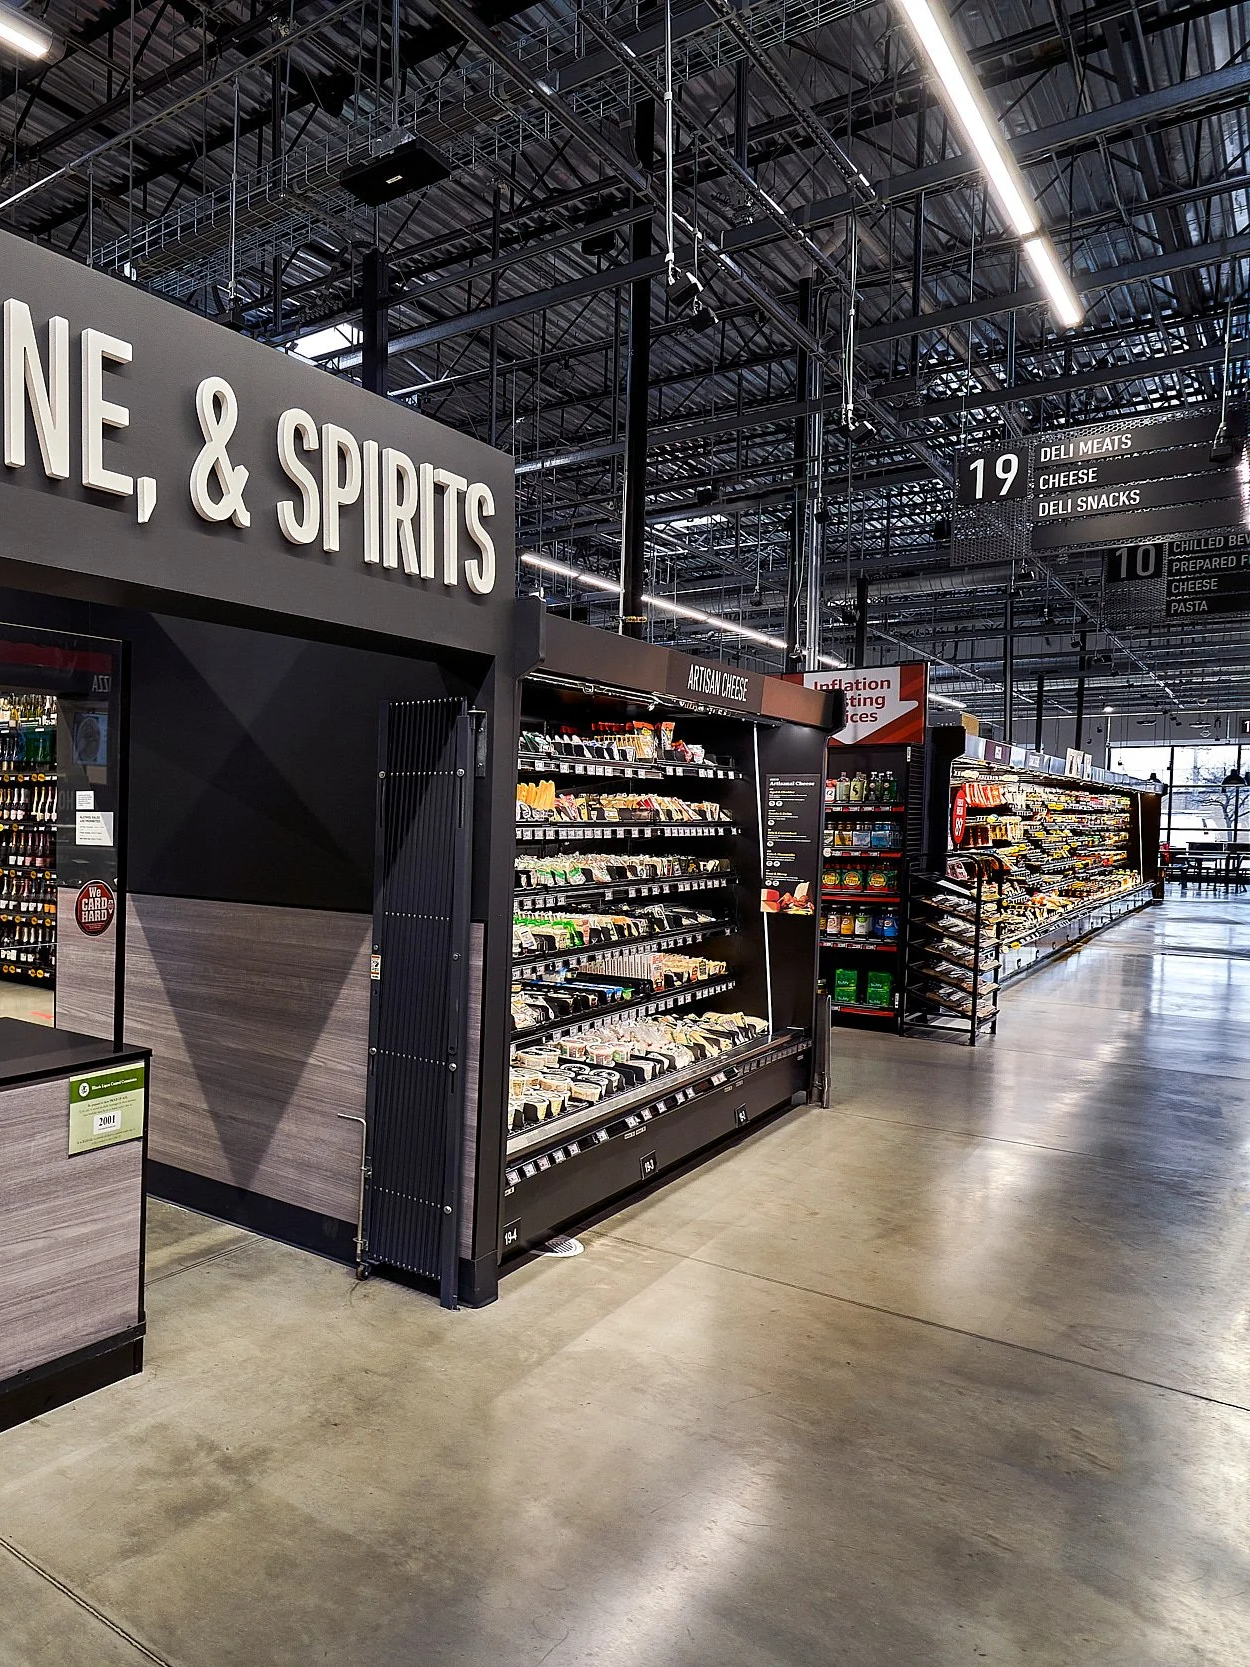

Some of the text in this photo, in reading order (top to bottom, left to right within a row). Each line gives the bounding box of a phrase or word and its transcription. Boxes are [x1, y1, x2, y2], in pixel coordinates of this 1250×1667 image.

[1040, 433, 1132, 463] DELI MEATS
[968, 453, 1020, 500] 19
[1039, 467, 1098, 490] CHEESE
[189, 376, 251, 529] &
[276, 407, 497, 595] SPIRITS
[1038, 489, 1141, 517] DELI SNACKS
[1173, 536, 1224, 552] CHILLED
[1115, 544, 1156, 579] 10
[1172, 555, 1237, 573] PREPARED
[1171, 578, 1219, 594] CHEESE
[1170, 600, 1209, 614] PASTA
[687, 664, 749, 702] ARTISAN CHEESE
[814, 677, 891, 692] Inflation
[846, 711, 878, 723] ices
[88, 886, 102, 898] We
[81, 897, 108, 911] CARD
[81, 910, 108, 923] HARD
[98, 1114, 116, 1127] 2001
[504, 1227, 518, 1246] 19-4
